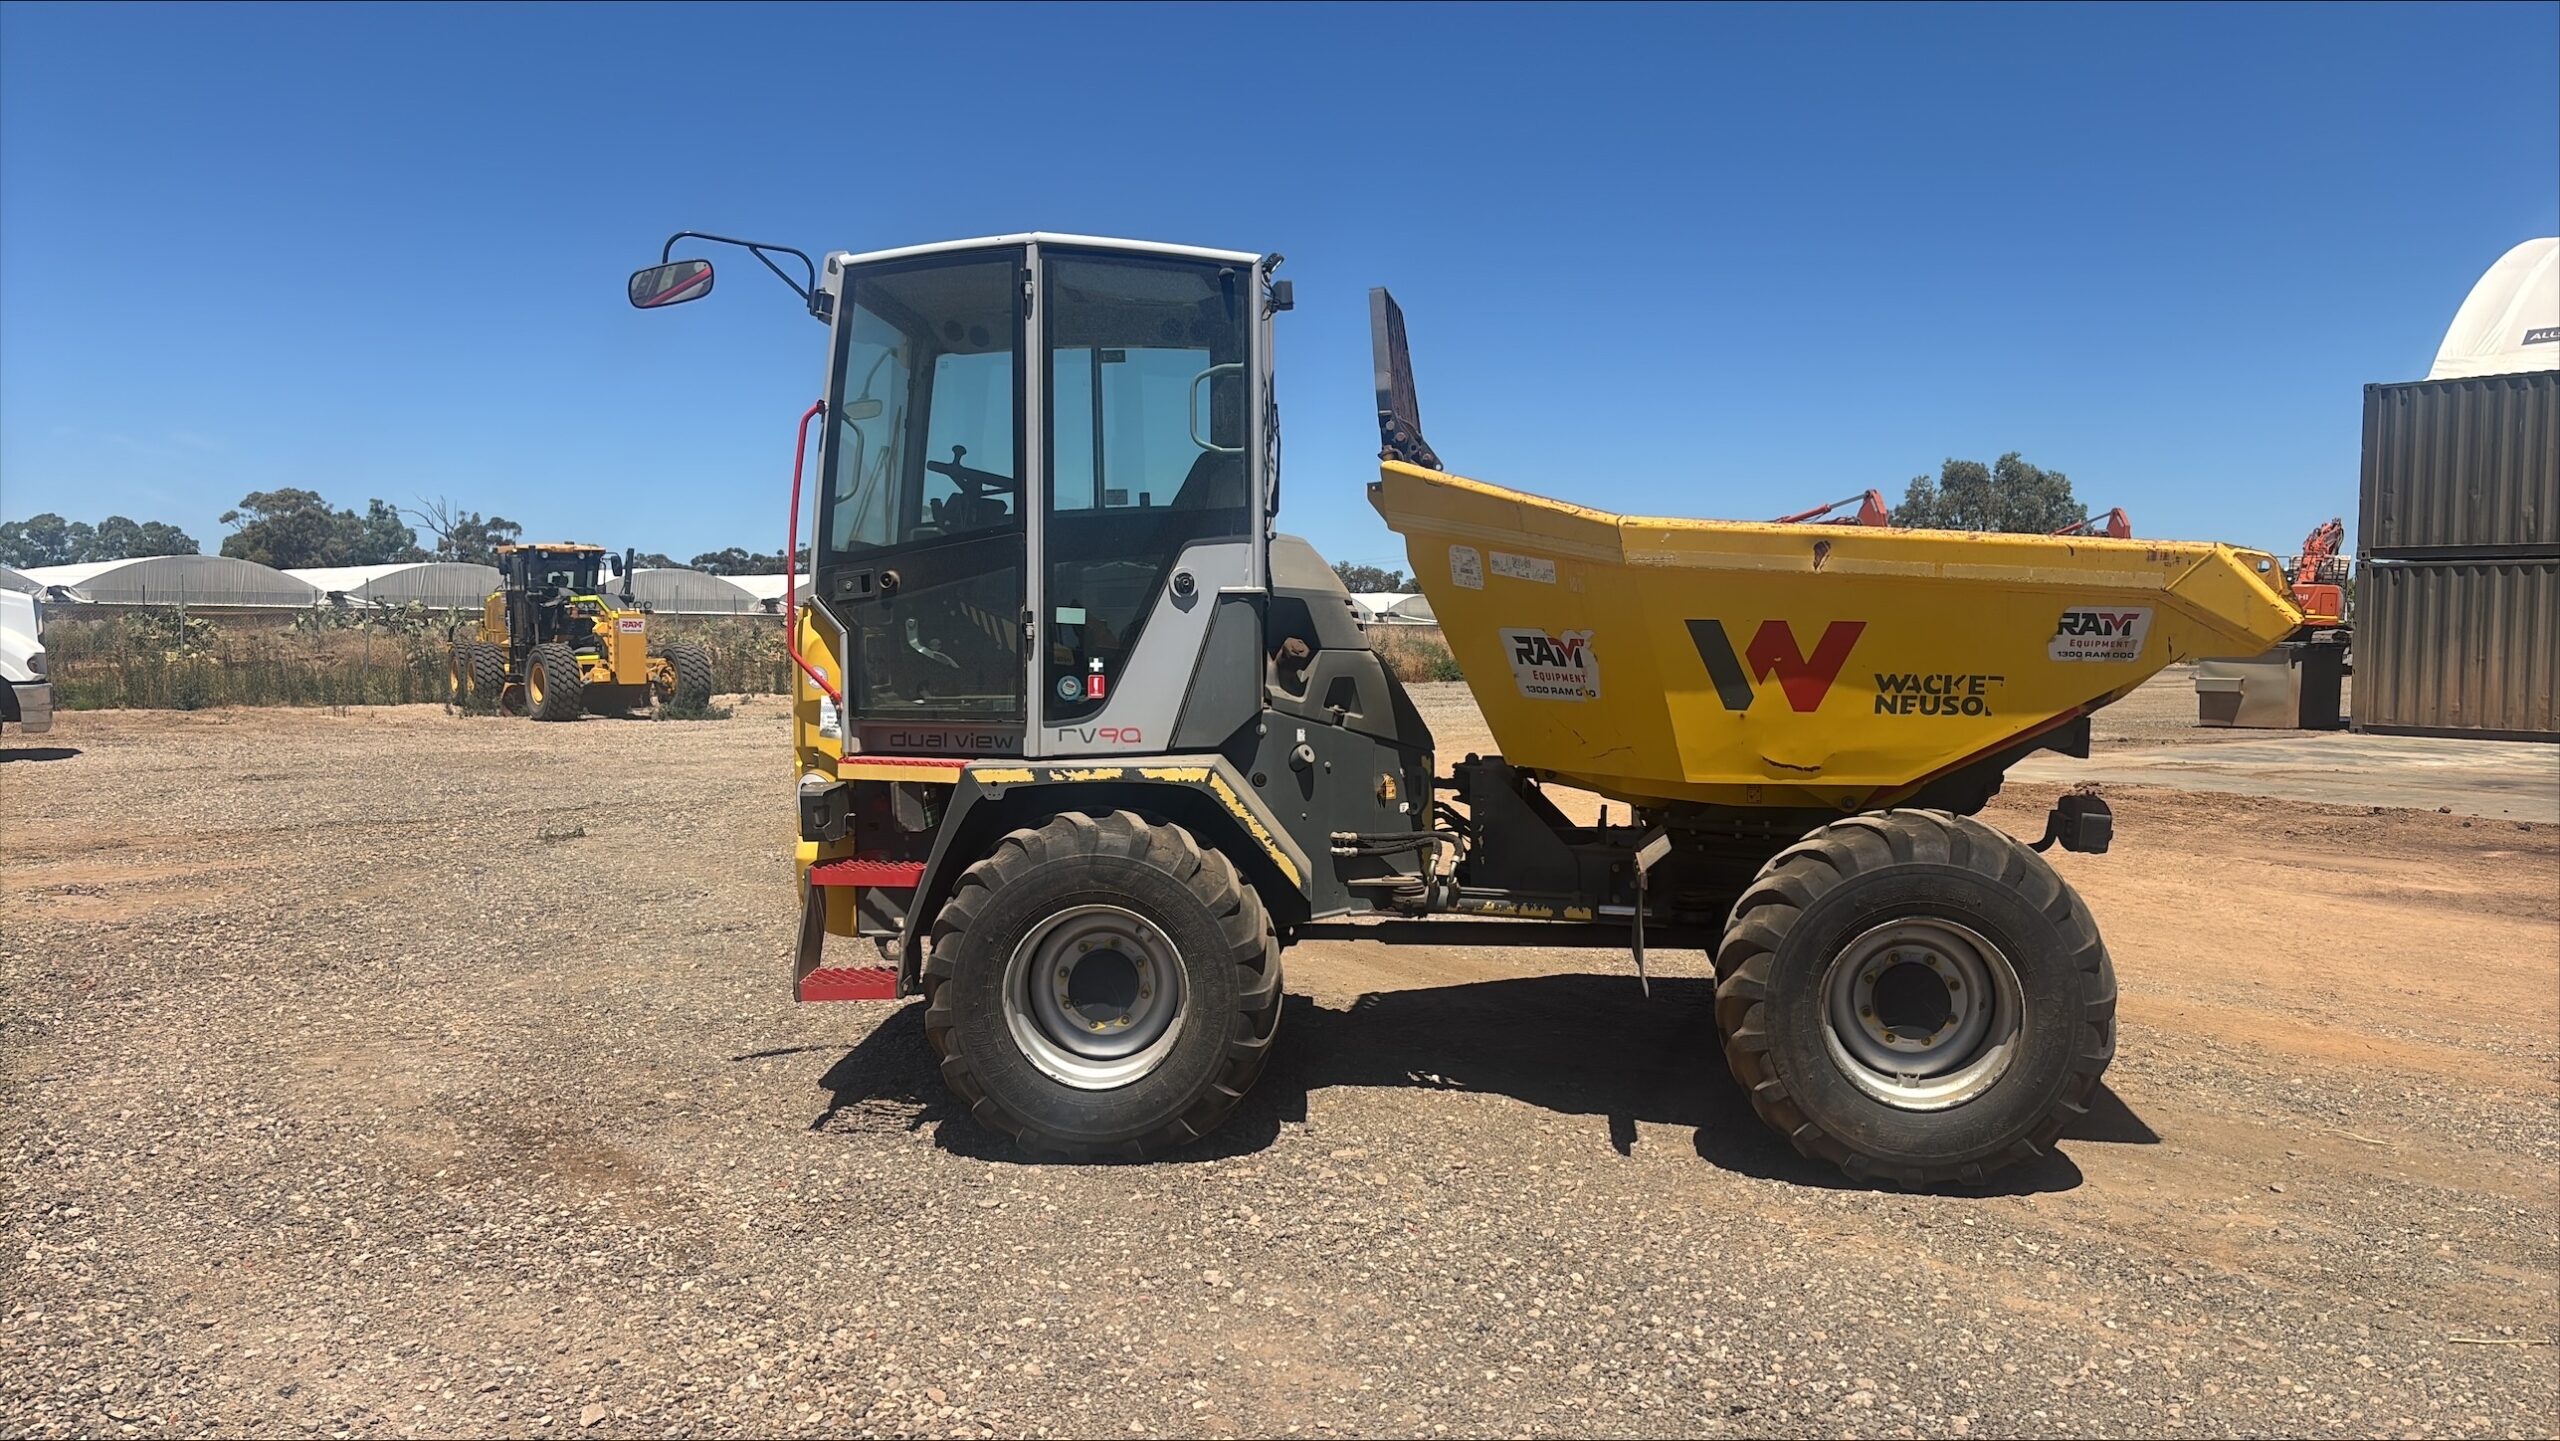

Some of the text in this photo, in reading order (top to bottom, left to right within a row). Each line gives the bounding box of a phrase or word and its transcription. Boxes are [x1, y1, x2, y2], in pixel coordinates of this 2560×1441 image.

[2057, 612, 2140, 637] RAM
[1512, 635, 1585, 668] RAM
[2057, 650, 2135, 660] 1300 RAM 000
[1532, 670, 1587, 684] EQUIPMENT
[1526, 684, 1550, 695] 1300
[1551, 685, 1575, 697] RAM
[1874, 694, 1993, 717] NEUSO
[889, 732, 948, 749] dual
[955, 732, 1014, 749] view
